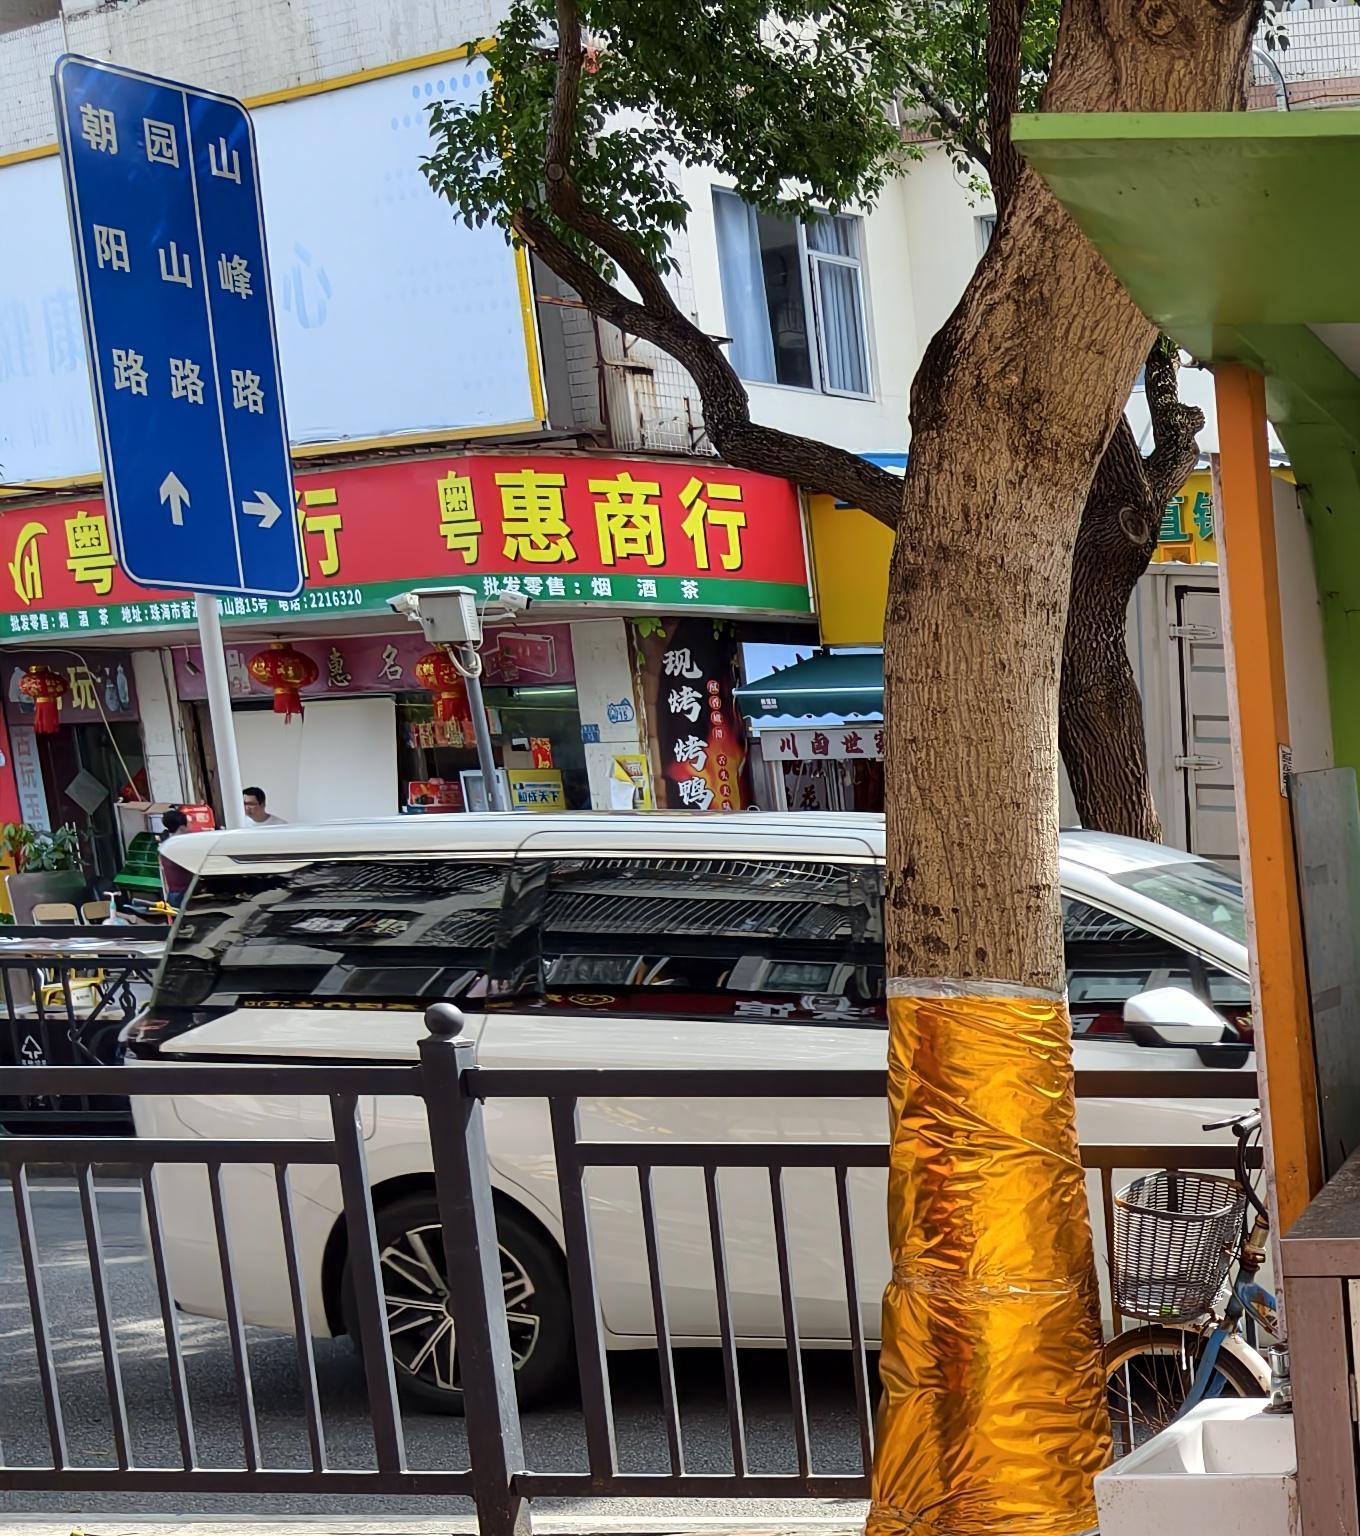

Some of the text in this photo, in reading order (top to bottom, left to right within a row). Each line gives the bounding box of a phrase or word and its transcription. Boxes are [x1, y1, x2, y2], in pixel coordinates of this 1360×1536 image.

[79, 104, 149, 397] 朝阳路
[143, 117, 205, 405] 园山路
[208, 137, 265, 414] 山峰路
[437, 468, 747, 572] 粤惠商行
[637, 578, 658, 598] 酒
[681, 579, 701, 600] 茶
[13, 726, 46, 832] 古玩玉
[663, 648, 714, 811] 现烤烤鸭
